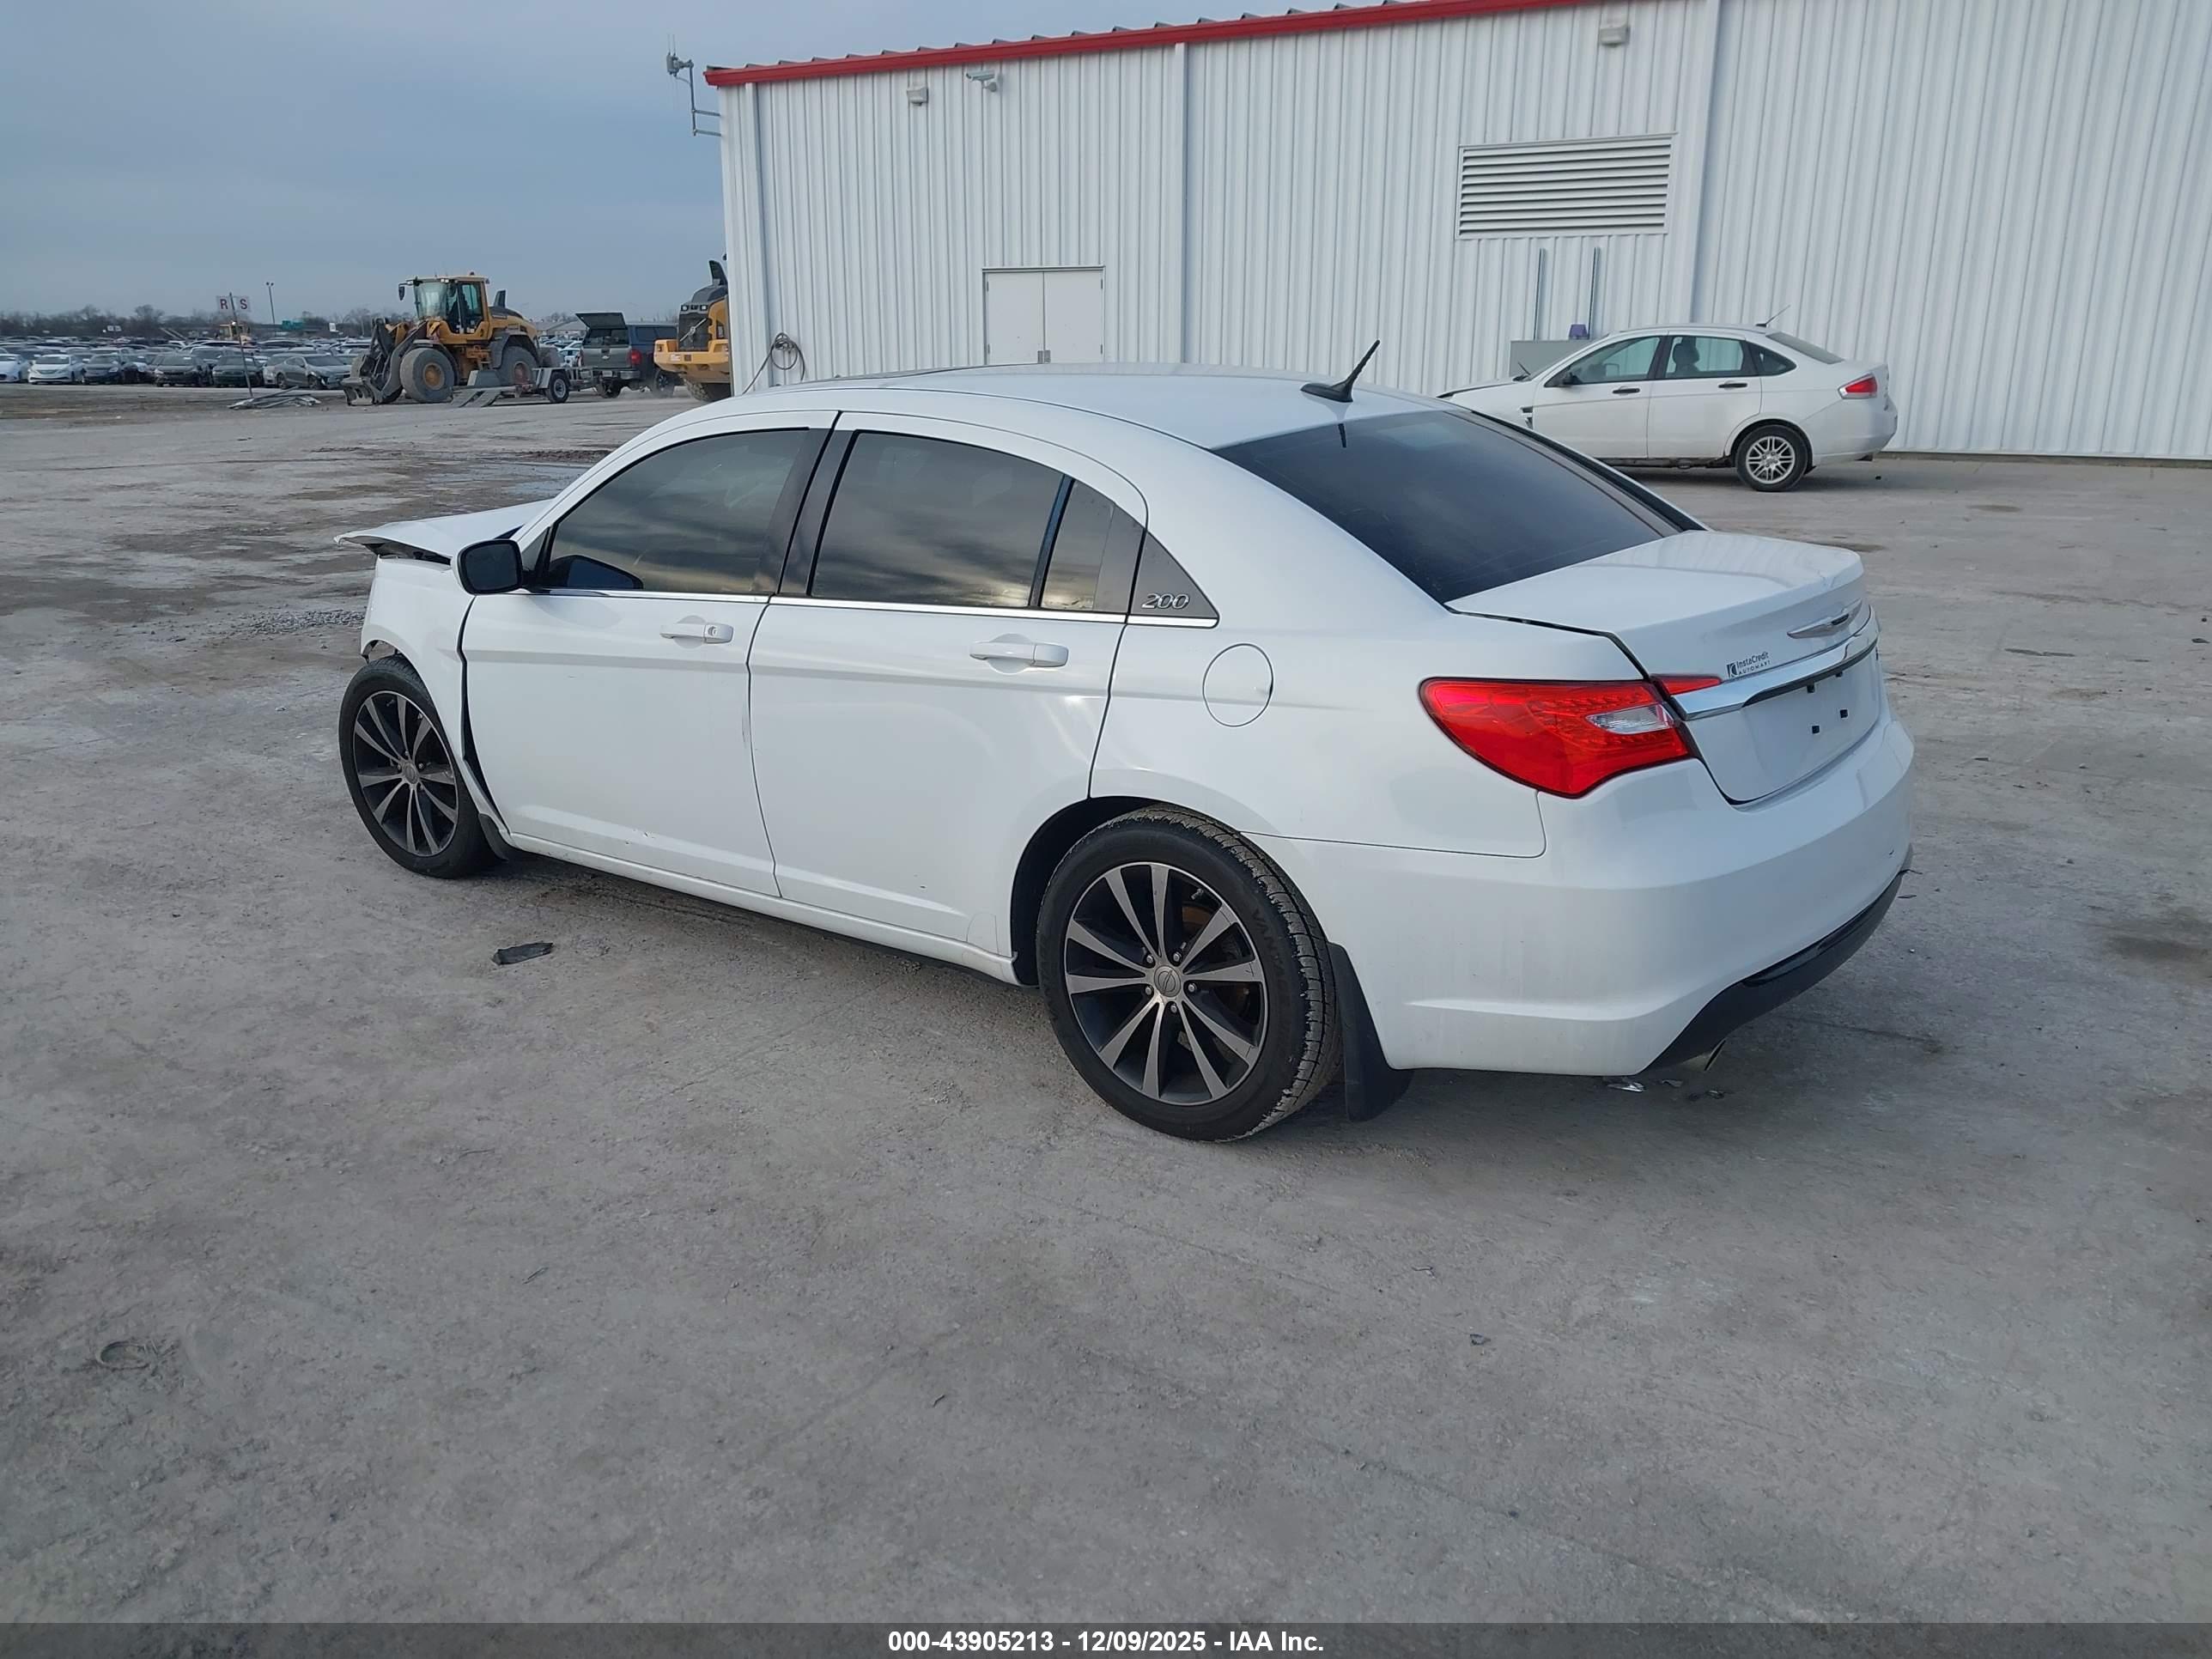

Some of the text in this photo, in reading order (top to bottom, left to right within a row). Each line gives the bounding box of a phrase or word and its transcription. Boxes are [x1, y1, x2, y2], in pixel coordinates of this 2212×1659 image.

[220, 298, 228, 310] R
[240, 298, 248, 310] S
[1141, 592, 1190, 610] 200
[1736, 651, 1769, 669] InstaCredit
